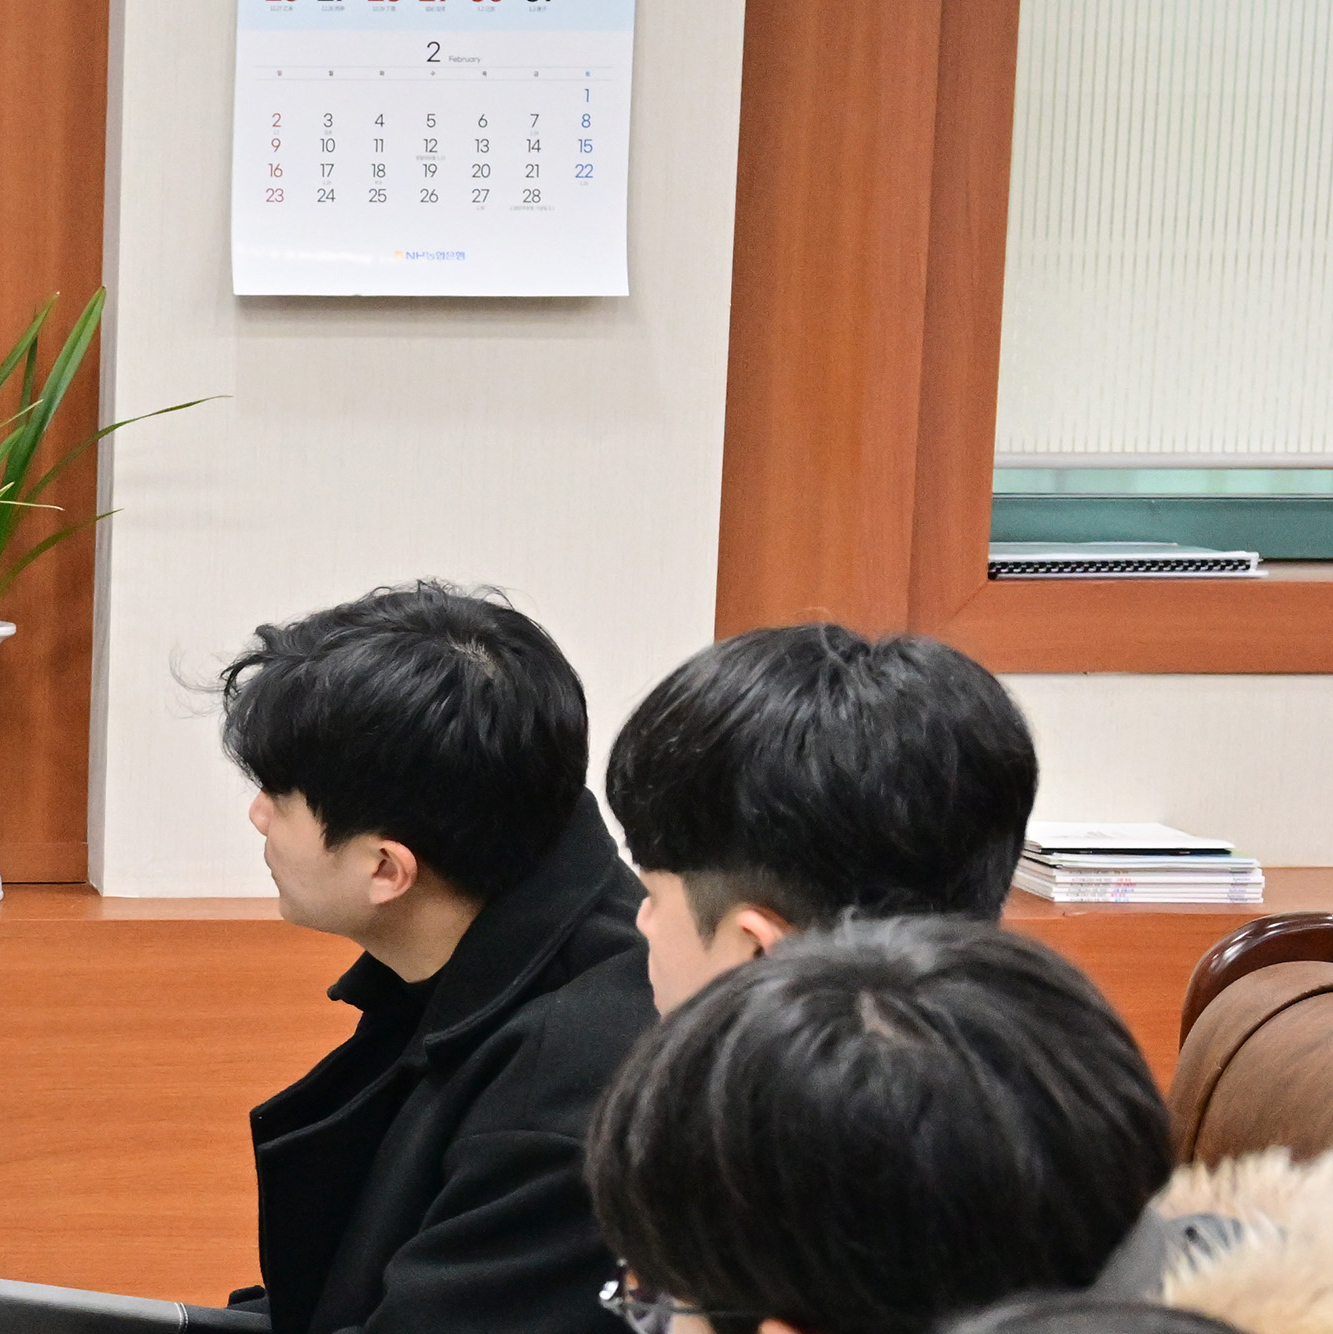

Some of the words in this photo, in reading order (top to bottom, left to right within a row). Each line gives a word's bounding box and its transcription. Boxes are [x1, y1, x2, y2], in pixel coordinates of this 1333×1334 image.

[426, 40, 442, 63] 2
[583, 88, 590, 103] 1
[272, 112, 282, 128] 2
[323, 112, 334, 128] 3
[374, 113, 385, 128] 4
[426, 113, 437, 129] 5
[477, 113, 488, 129] 6
[530, 113, 540, 128] 7
[580, 112, 592, 129] 8
[270, 137, 281, 153] 9
[319, 137, 336, 153] 10
[373, 138, 384, 153] 11
[423, 138, 438, 153] 12
[474, 138, 490, 154] 13
[526, 138, 542, 153] 14
[577, 138, 594, 154] 15
[268, 163, 283, 178] 16
[320, 163, 335, 178] 17
[371, 163, 386, 179] 18
[422, 163, 438, 178] 19
[471, 163, 491, 179] 20
[525, 163, 540, 179] 21
[574, 163, 594, 179] 22
[265, 187, 284, 203] 23
[316, 188, 336, 203] 24
[368, 188, 388, 203] 25
[420, 188, 439, 204] 26
[471, 188, 490, 203] 27
[522, 188, 542, 204] 28
